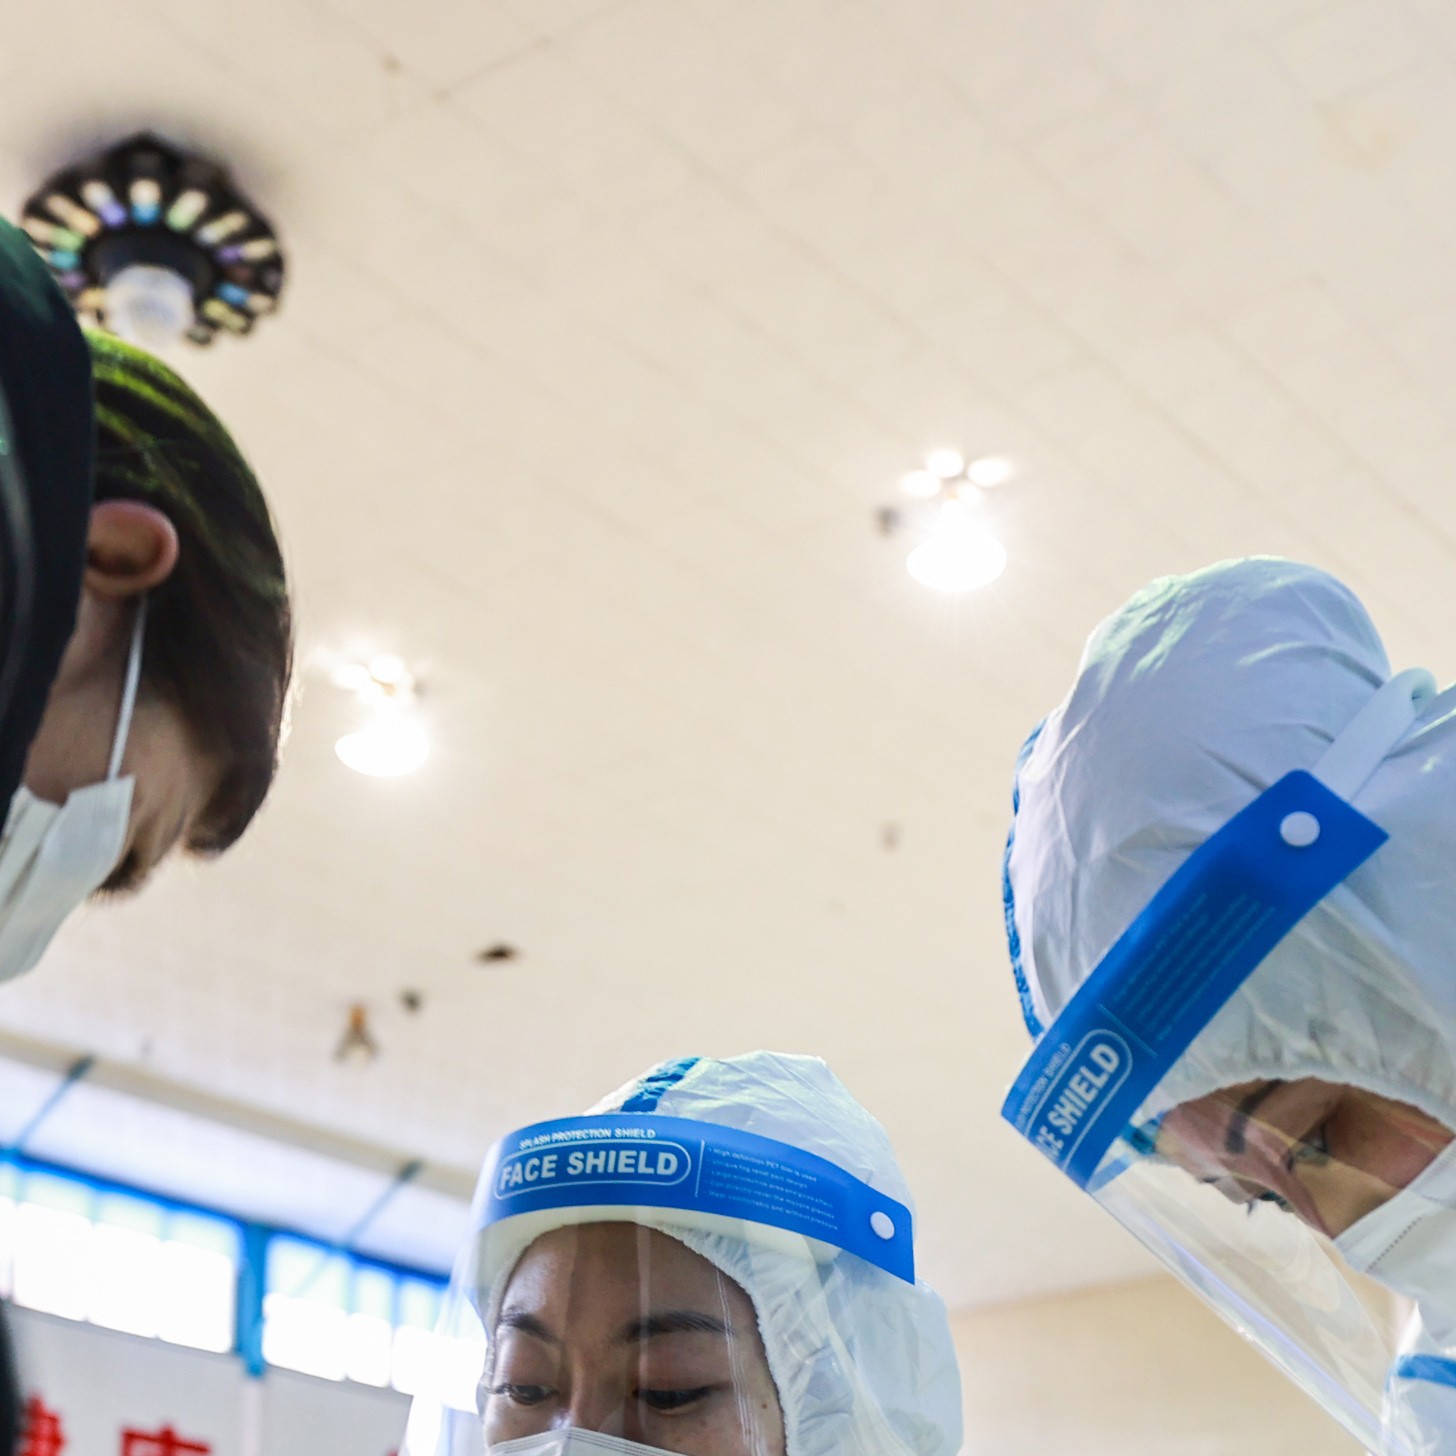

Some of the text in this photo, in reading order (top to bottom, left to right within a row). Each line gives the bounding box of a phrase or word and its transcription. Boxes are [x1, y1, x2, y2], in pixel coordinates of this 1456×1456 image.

[1047, 1043, 1121, 1136] SHIELD
[551, 1128, 612, 1143] PROTECTION
[614, 1128, 657, 1140] SHIELD
[499, 1149, 678, 1191] FACE SHIELD
